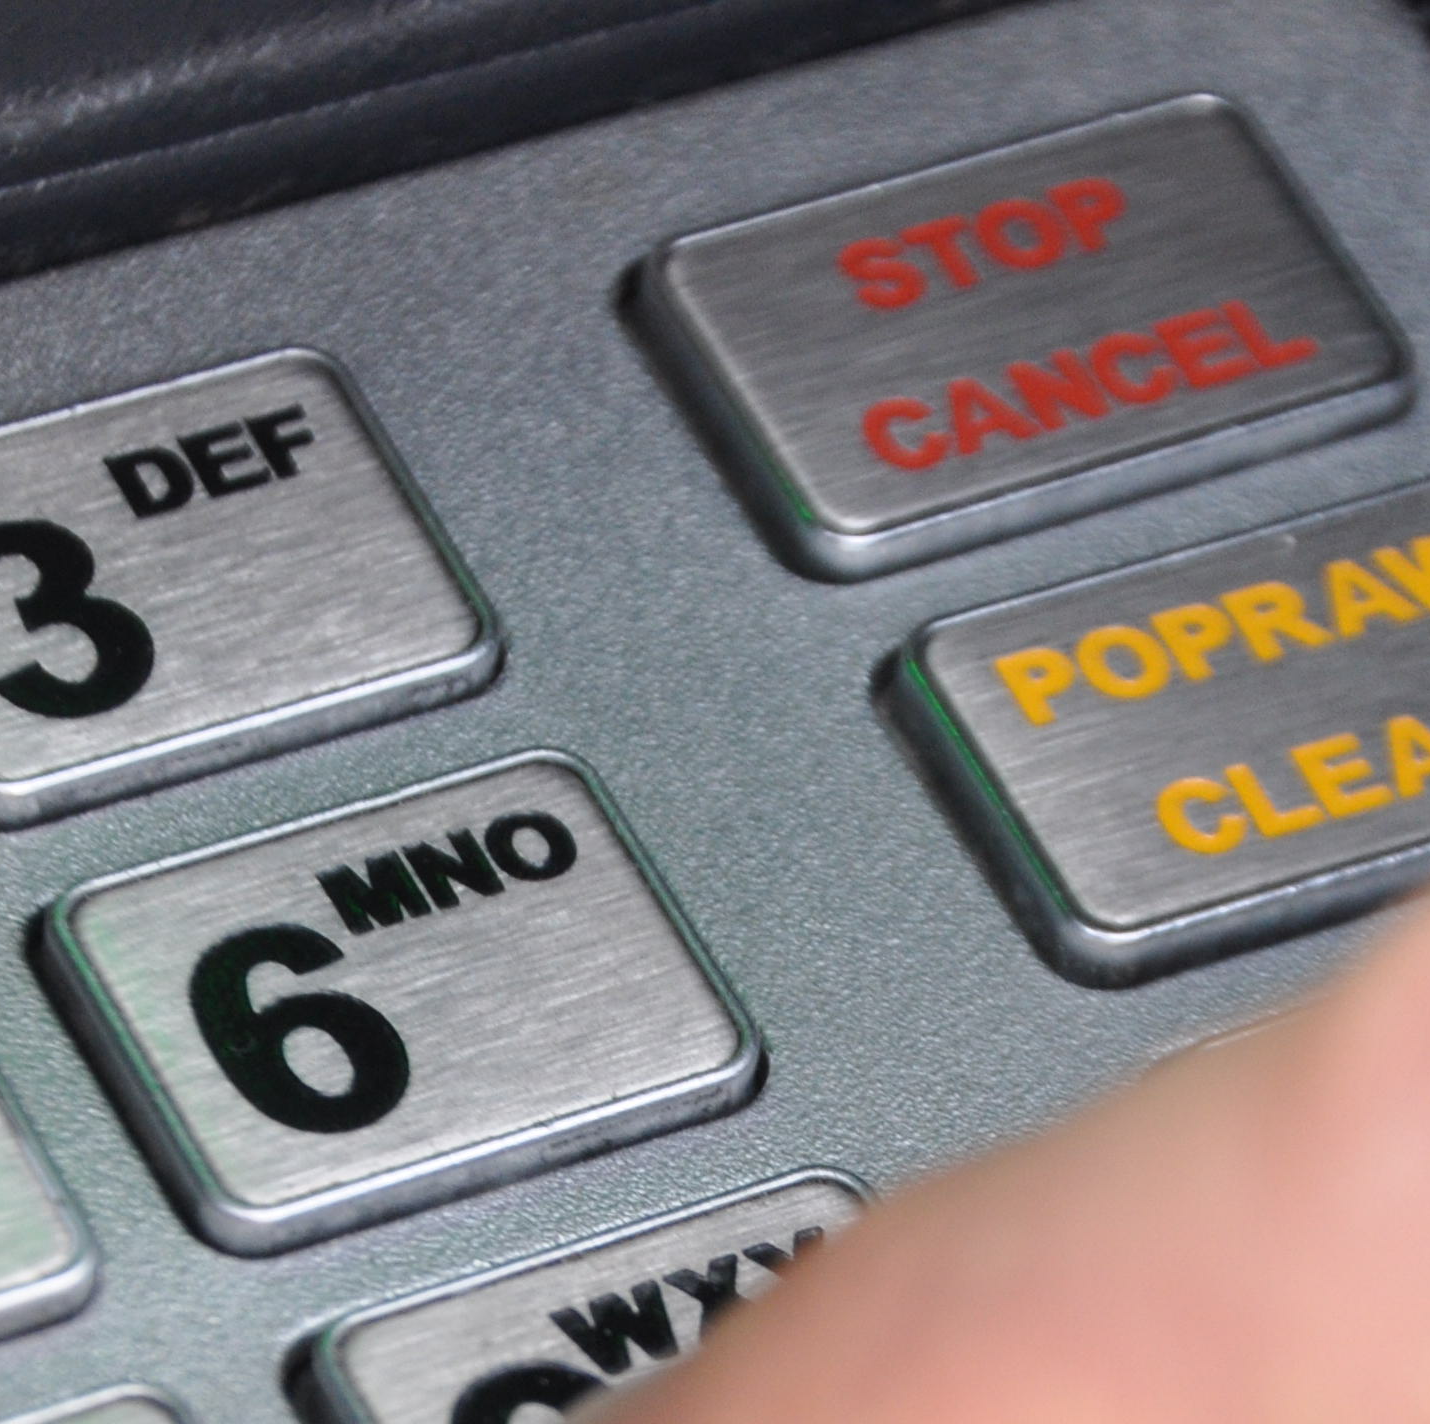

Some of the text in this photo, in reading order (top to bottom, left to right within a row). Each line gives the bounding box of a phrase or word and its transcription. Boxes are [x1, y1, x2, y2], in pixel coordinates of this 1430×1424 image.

[836, 175, 1128, 312] STOP
[859, 298, 1319, 472] CANCEL
[103, 403, 316, 518] DEF
[317, 812, 577, 936] MNO
[188, 924, 411, 1133] 6
